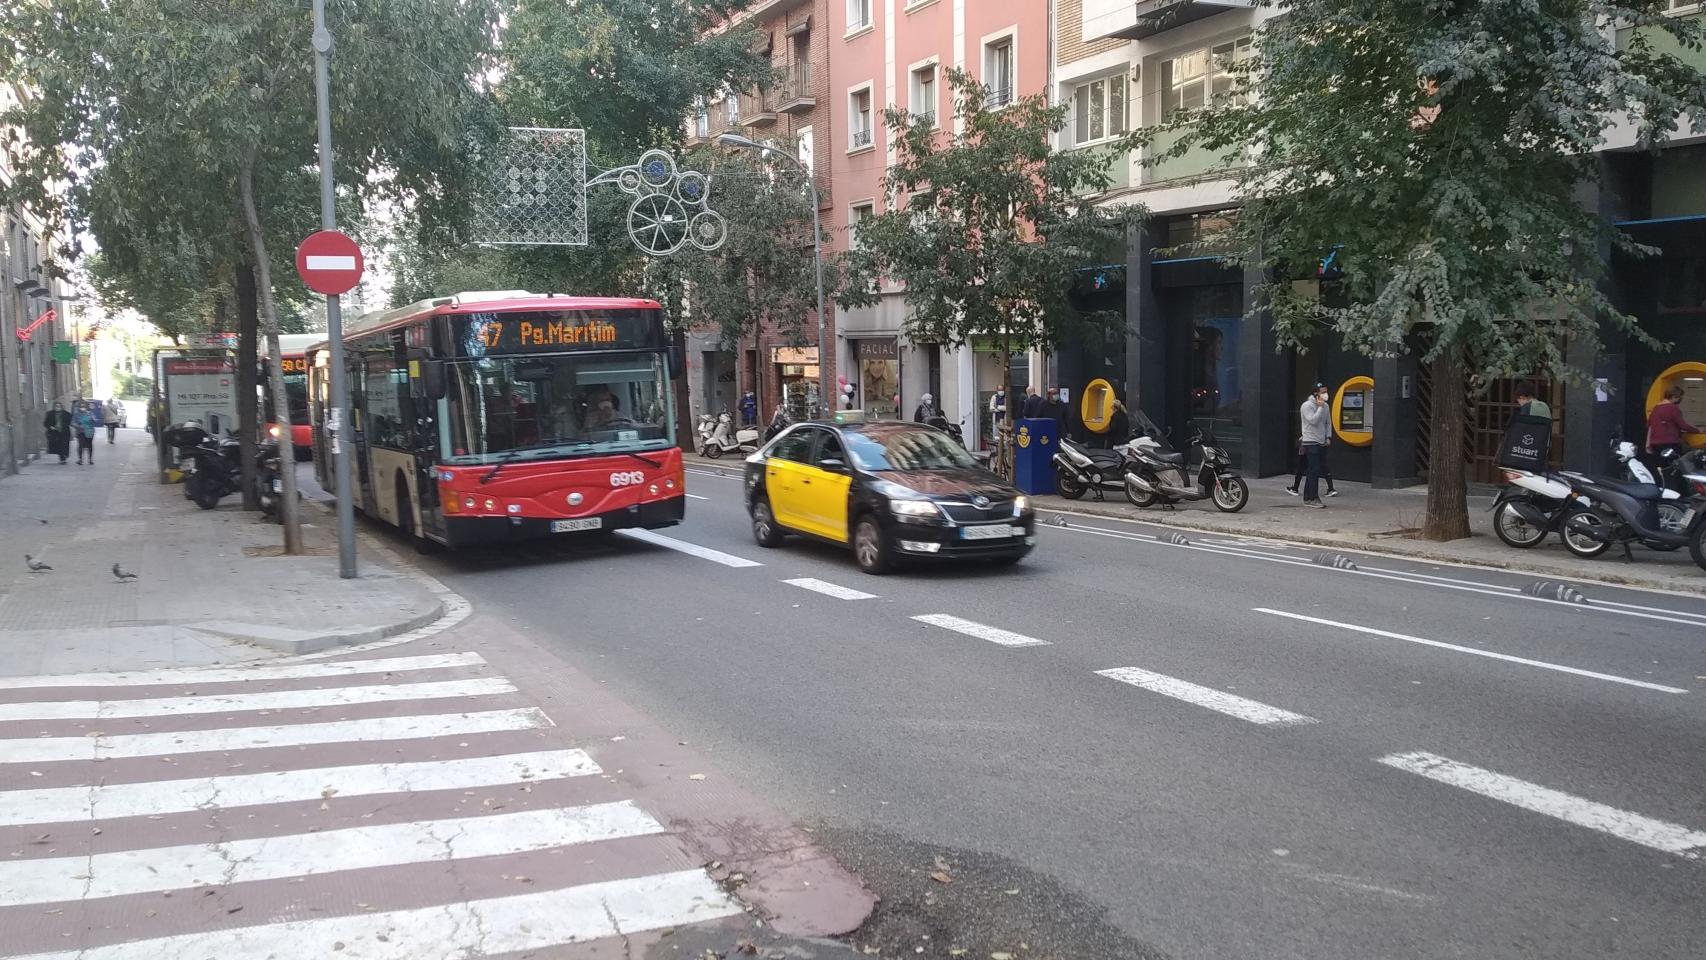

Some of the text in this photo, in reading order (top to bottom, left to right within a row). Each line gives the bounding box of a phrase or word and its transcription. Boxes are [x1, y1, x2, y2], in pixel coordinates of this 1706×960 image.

[860, 343, 894, 354] FACIAL
[1511, 446, 1539, 456] stuart
[611, 470, 644, 487] 6913
